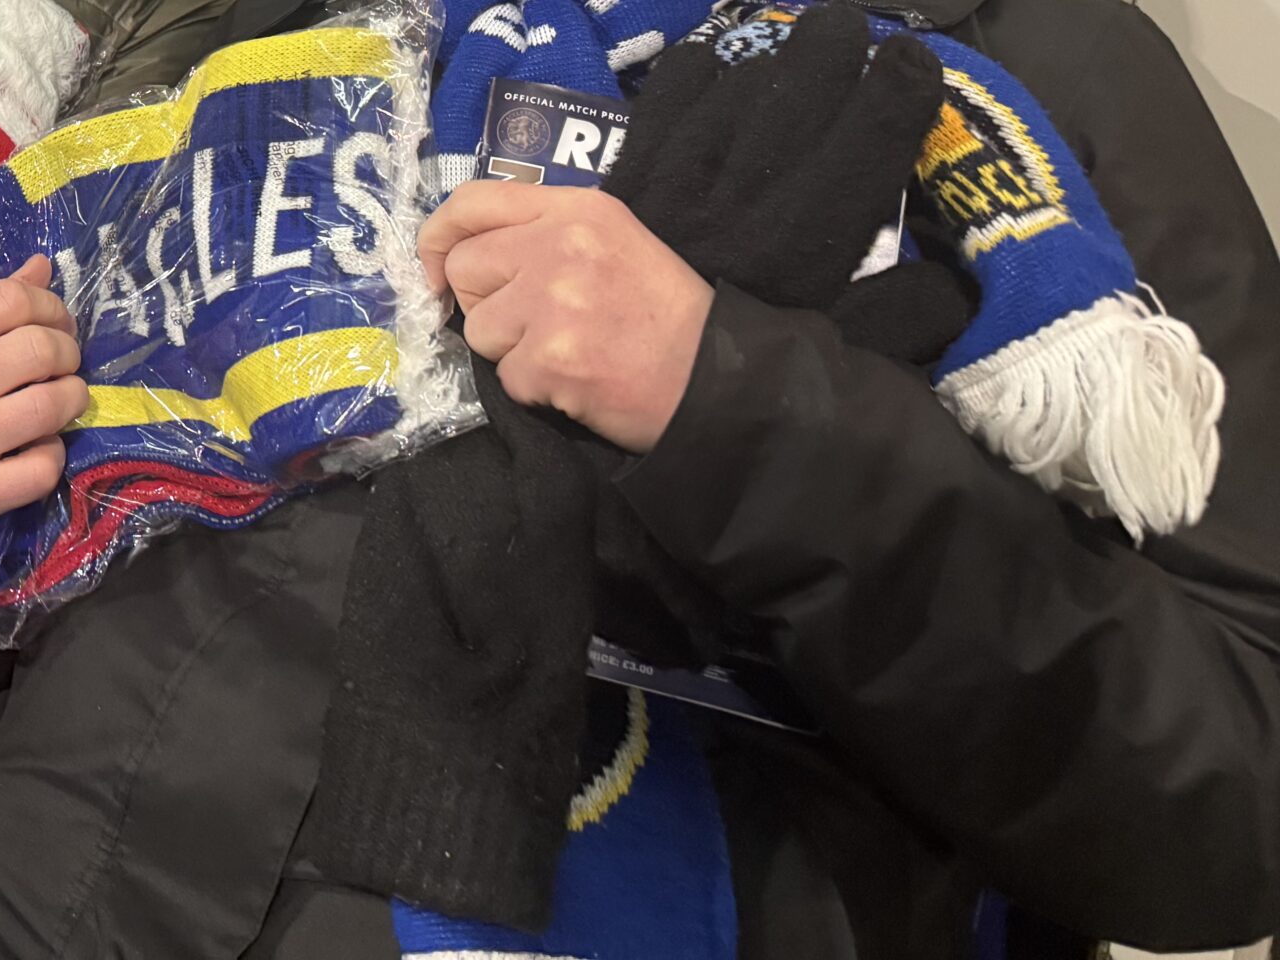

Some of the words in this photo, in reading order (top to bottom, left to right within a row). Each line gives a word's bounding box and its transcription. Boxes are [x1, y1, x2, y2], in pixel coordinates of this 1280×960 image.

[504, 92, 555, 108] OFFICIAL
[558, 102, 597, 117] MATCH
[622, 659, 655, 676] £3.00
